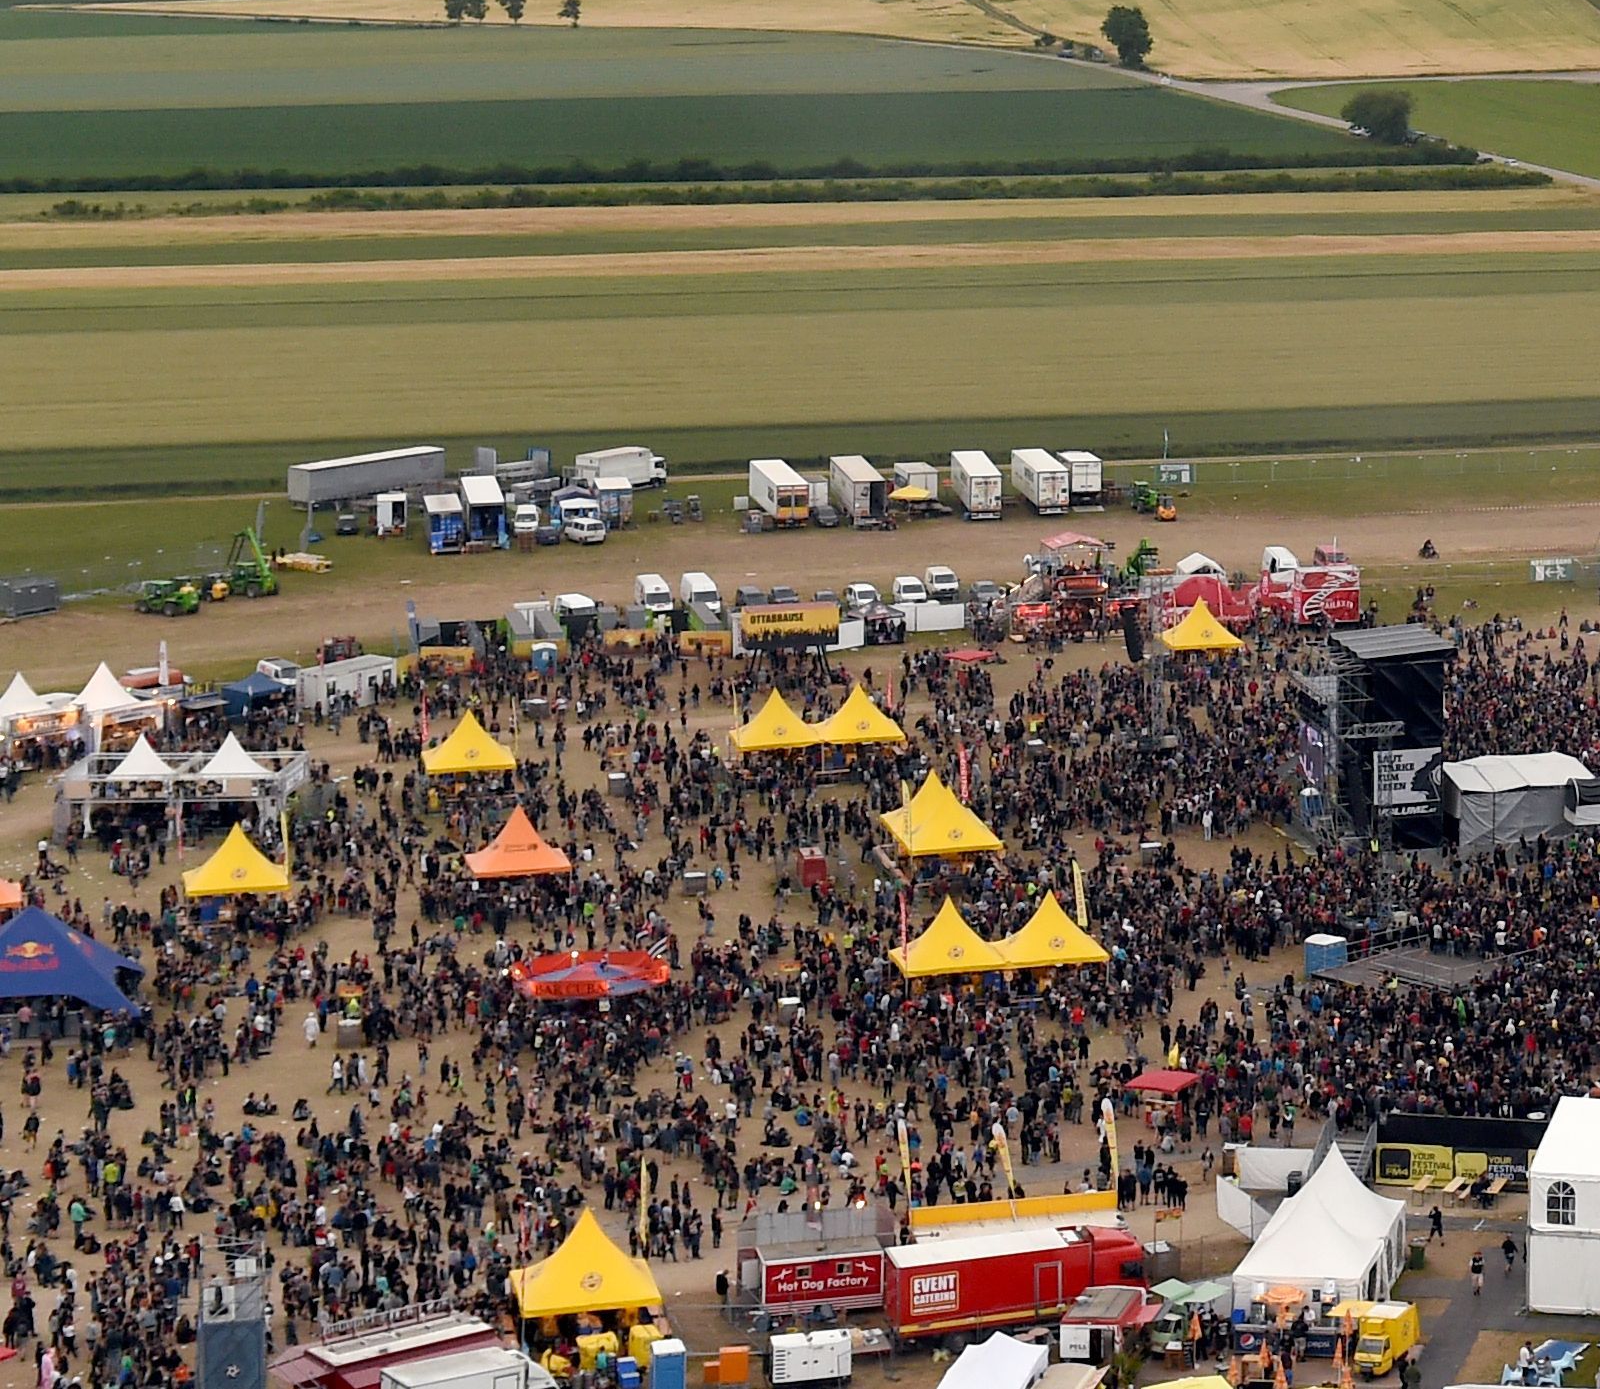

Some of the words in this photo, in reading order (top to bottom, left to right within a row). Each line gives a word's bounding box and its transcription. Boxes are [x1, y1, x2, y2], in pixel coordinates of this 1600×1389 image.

[1413, 1153, 1436, 1161] YOUR
[1488, 1156, 1512, 1164] YOUR
[1412, 1161, 1451, 1170] FESTIVAL
[1488, 1164, 1528, 1173] FESTIVAL
[777, 1281, 799, 1293] Hot
[801, 1279, 824, 1291] Dog
[827, 1276, 869, 1288] Factory
[913, 1274, 956, 1294] EVENT
[913, 1290, 956, 1306] CATERING
